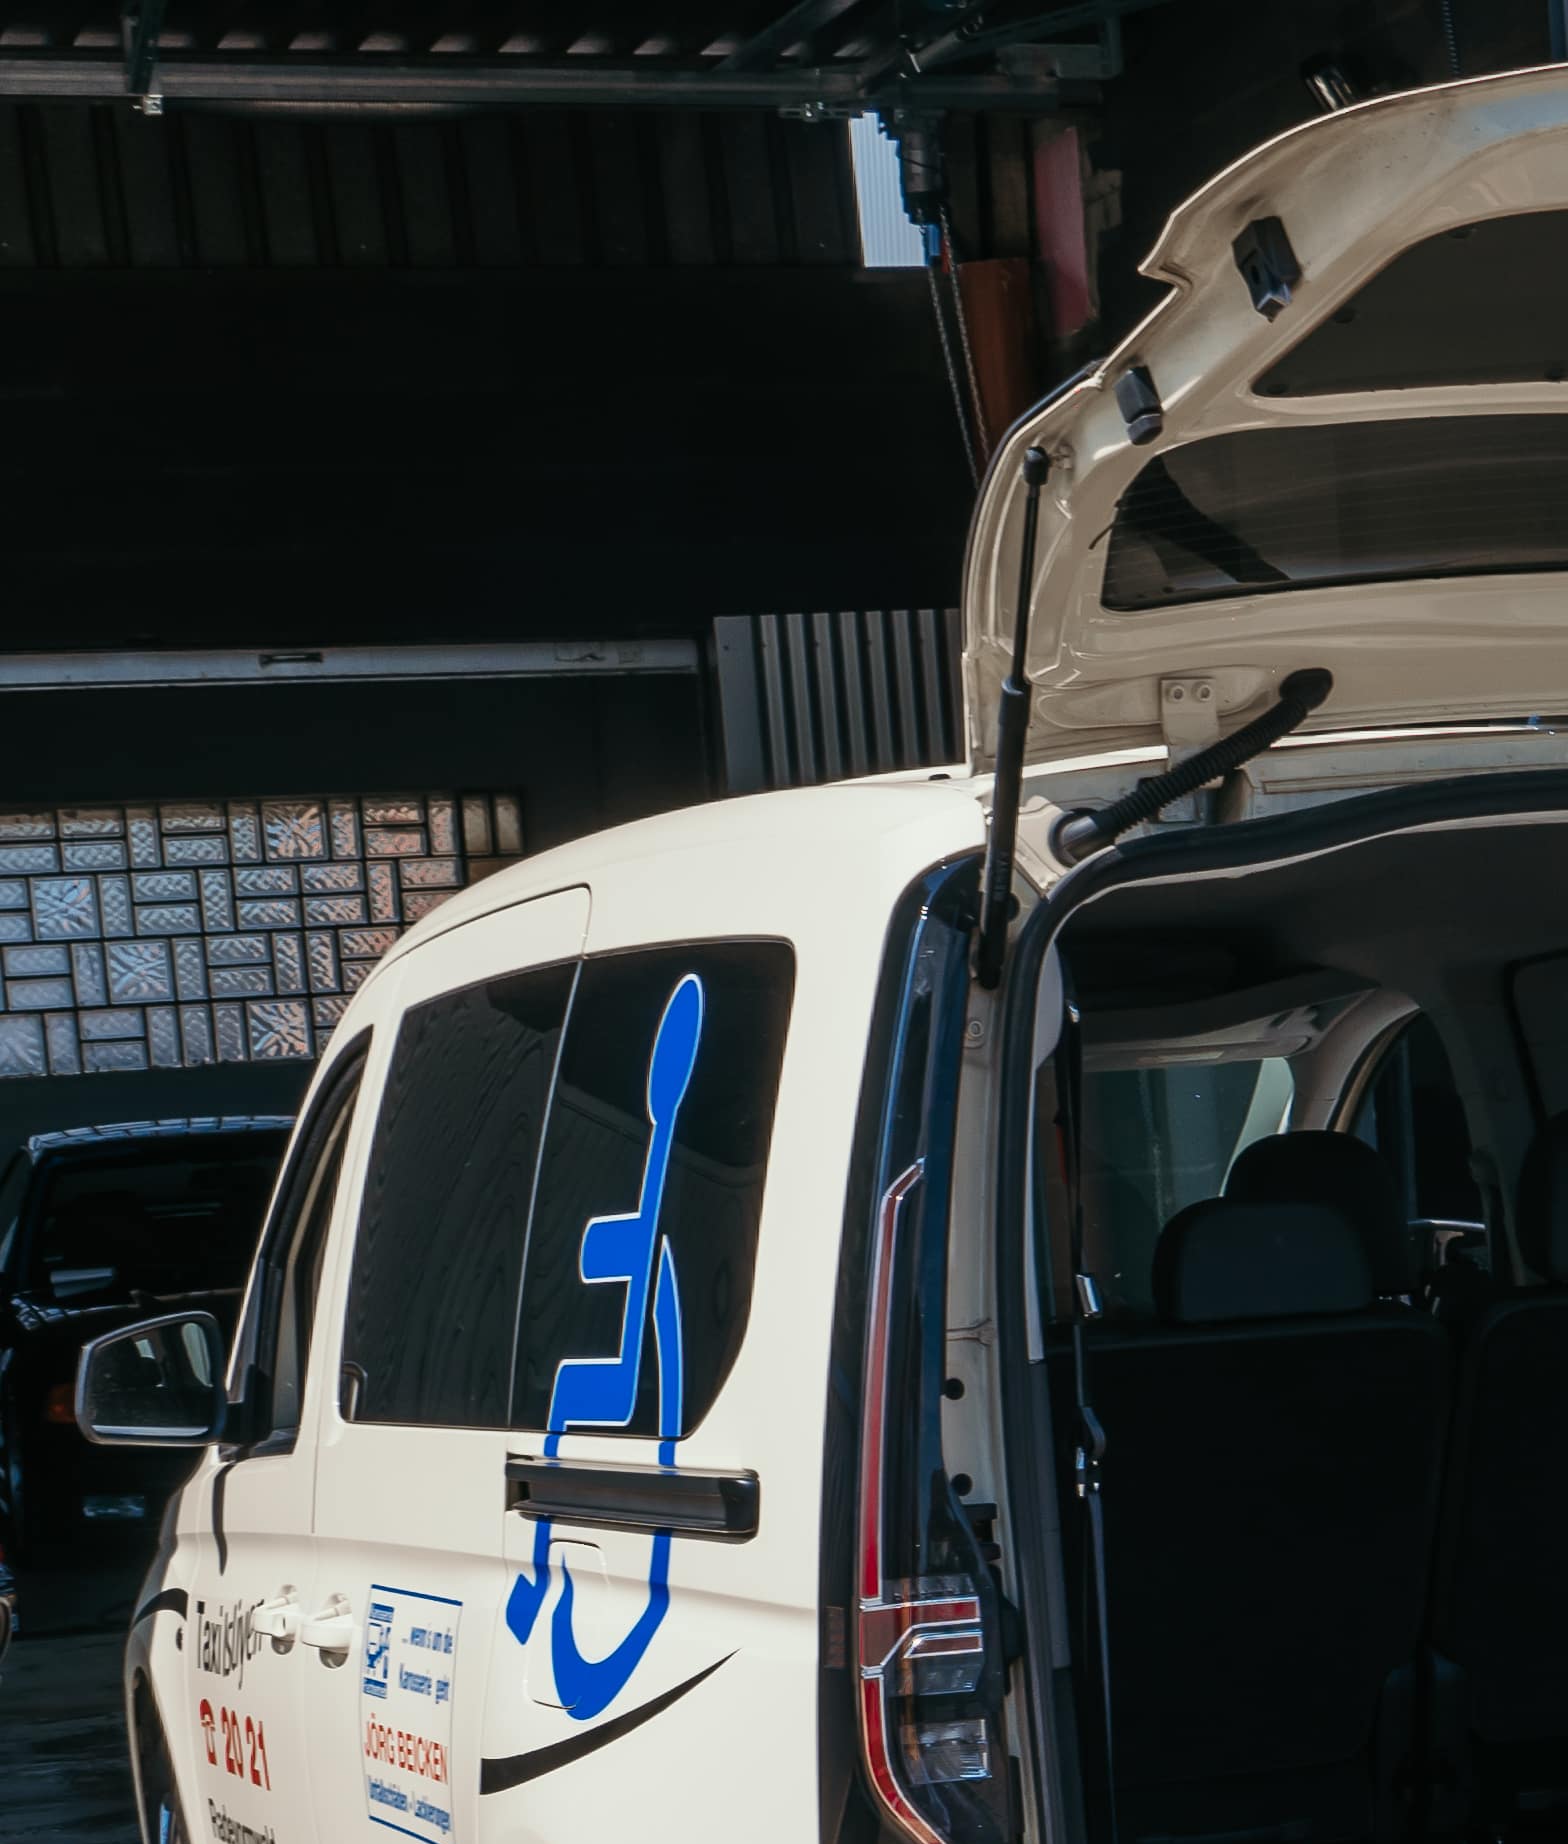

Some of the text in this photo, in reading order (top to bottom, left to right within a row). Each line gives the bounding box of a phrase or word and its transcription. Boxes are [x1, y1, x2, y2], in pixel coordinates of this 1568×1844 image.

[221, 1706, 271, 1791] 20 21
[364, 1712, 448, 1785] JÖRG BEICKEN
